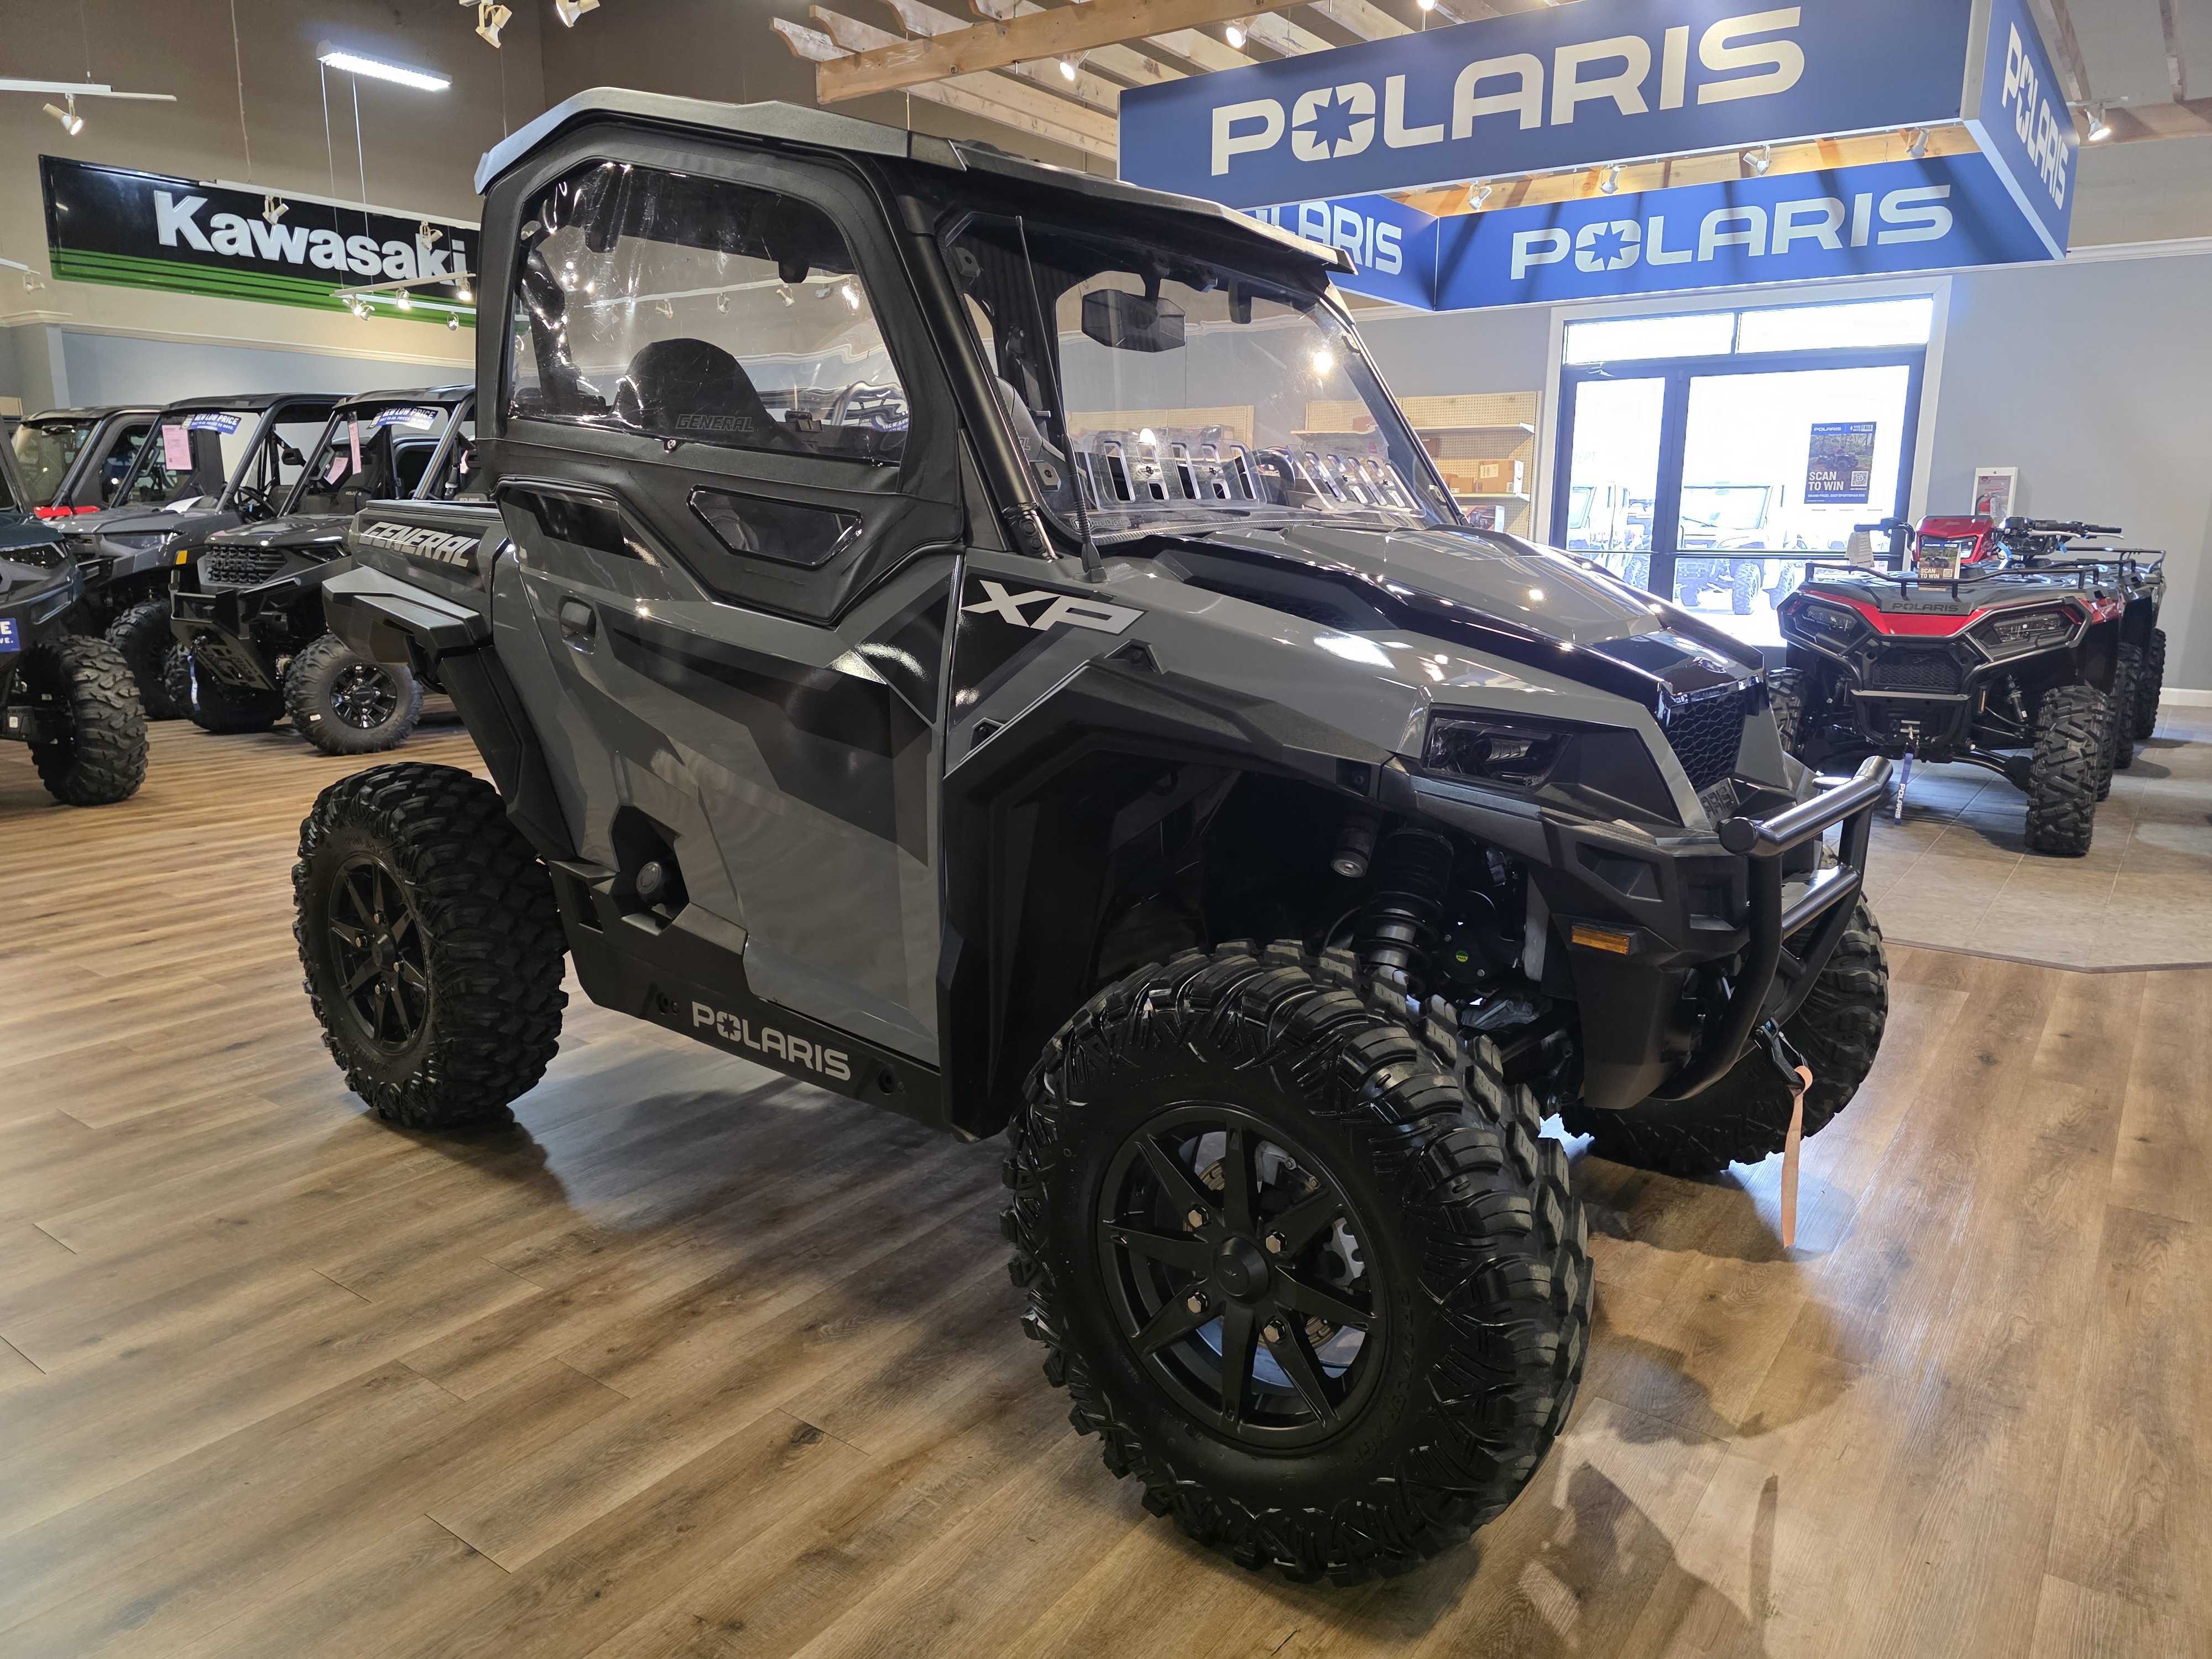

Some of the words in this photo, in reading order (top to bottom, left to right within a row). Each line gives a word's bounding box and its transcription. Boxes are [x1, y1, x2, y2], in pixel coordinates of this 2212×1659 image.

[1211, 6, 1805, 176] POLARIS
[2002, 22, 2068, 210] POLARIS
[154, 190, 466, 285] Kawasaki
[1510, 185, 1953, 280] POLARIS
[217, 415, 239, 425] PRICE
[394, 408, 412, 416] LOW
[410, 409, 436, 419] PRICE
[675, 414, 754, 432] GENERAL
[1808, 482, 1822, 491] TO
[1824, 481, 1844, 491] WIN
[1809, 471, 1837, 481] SCAN
[358, 522, 480, 567] GENERAL
[210, 557, 255, 571] POLARIS
[961, 580, 1145, 634] XP
[1892, 603, 1959, 612] POLARIS
[1895, 783, 1906, 819] POLARIS
[692, 1001, 851, 1082] POLARIS
